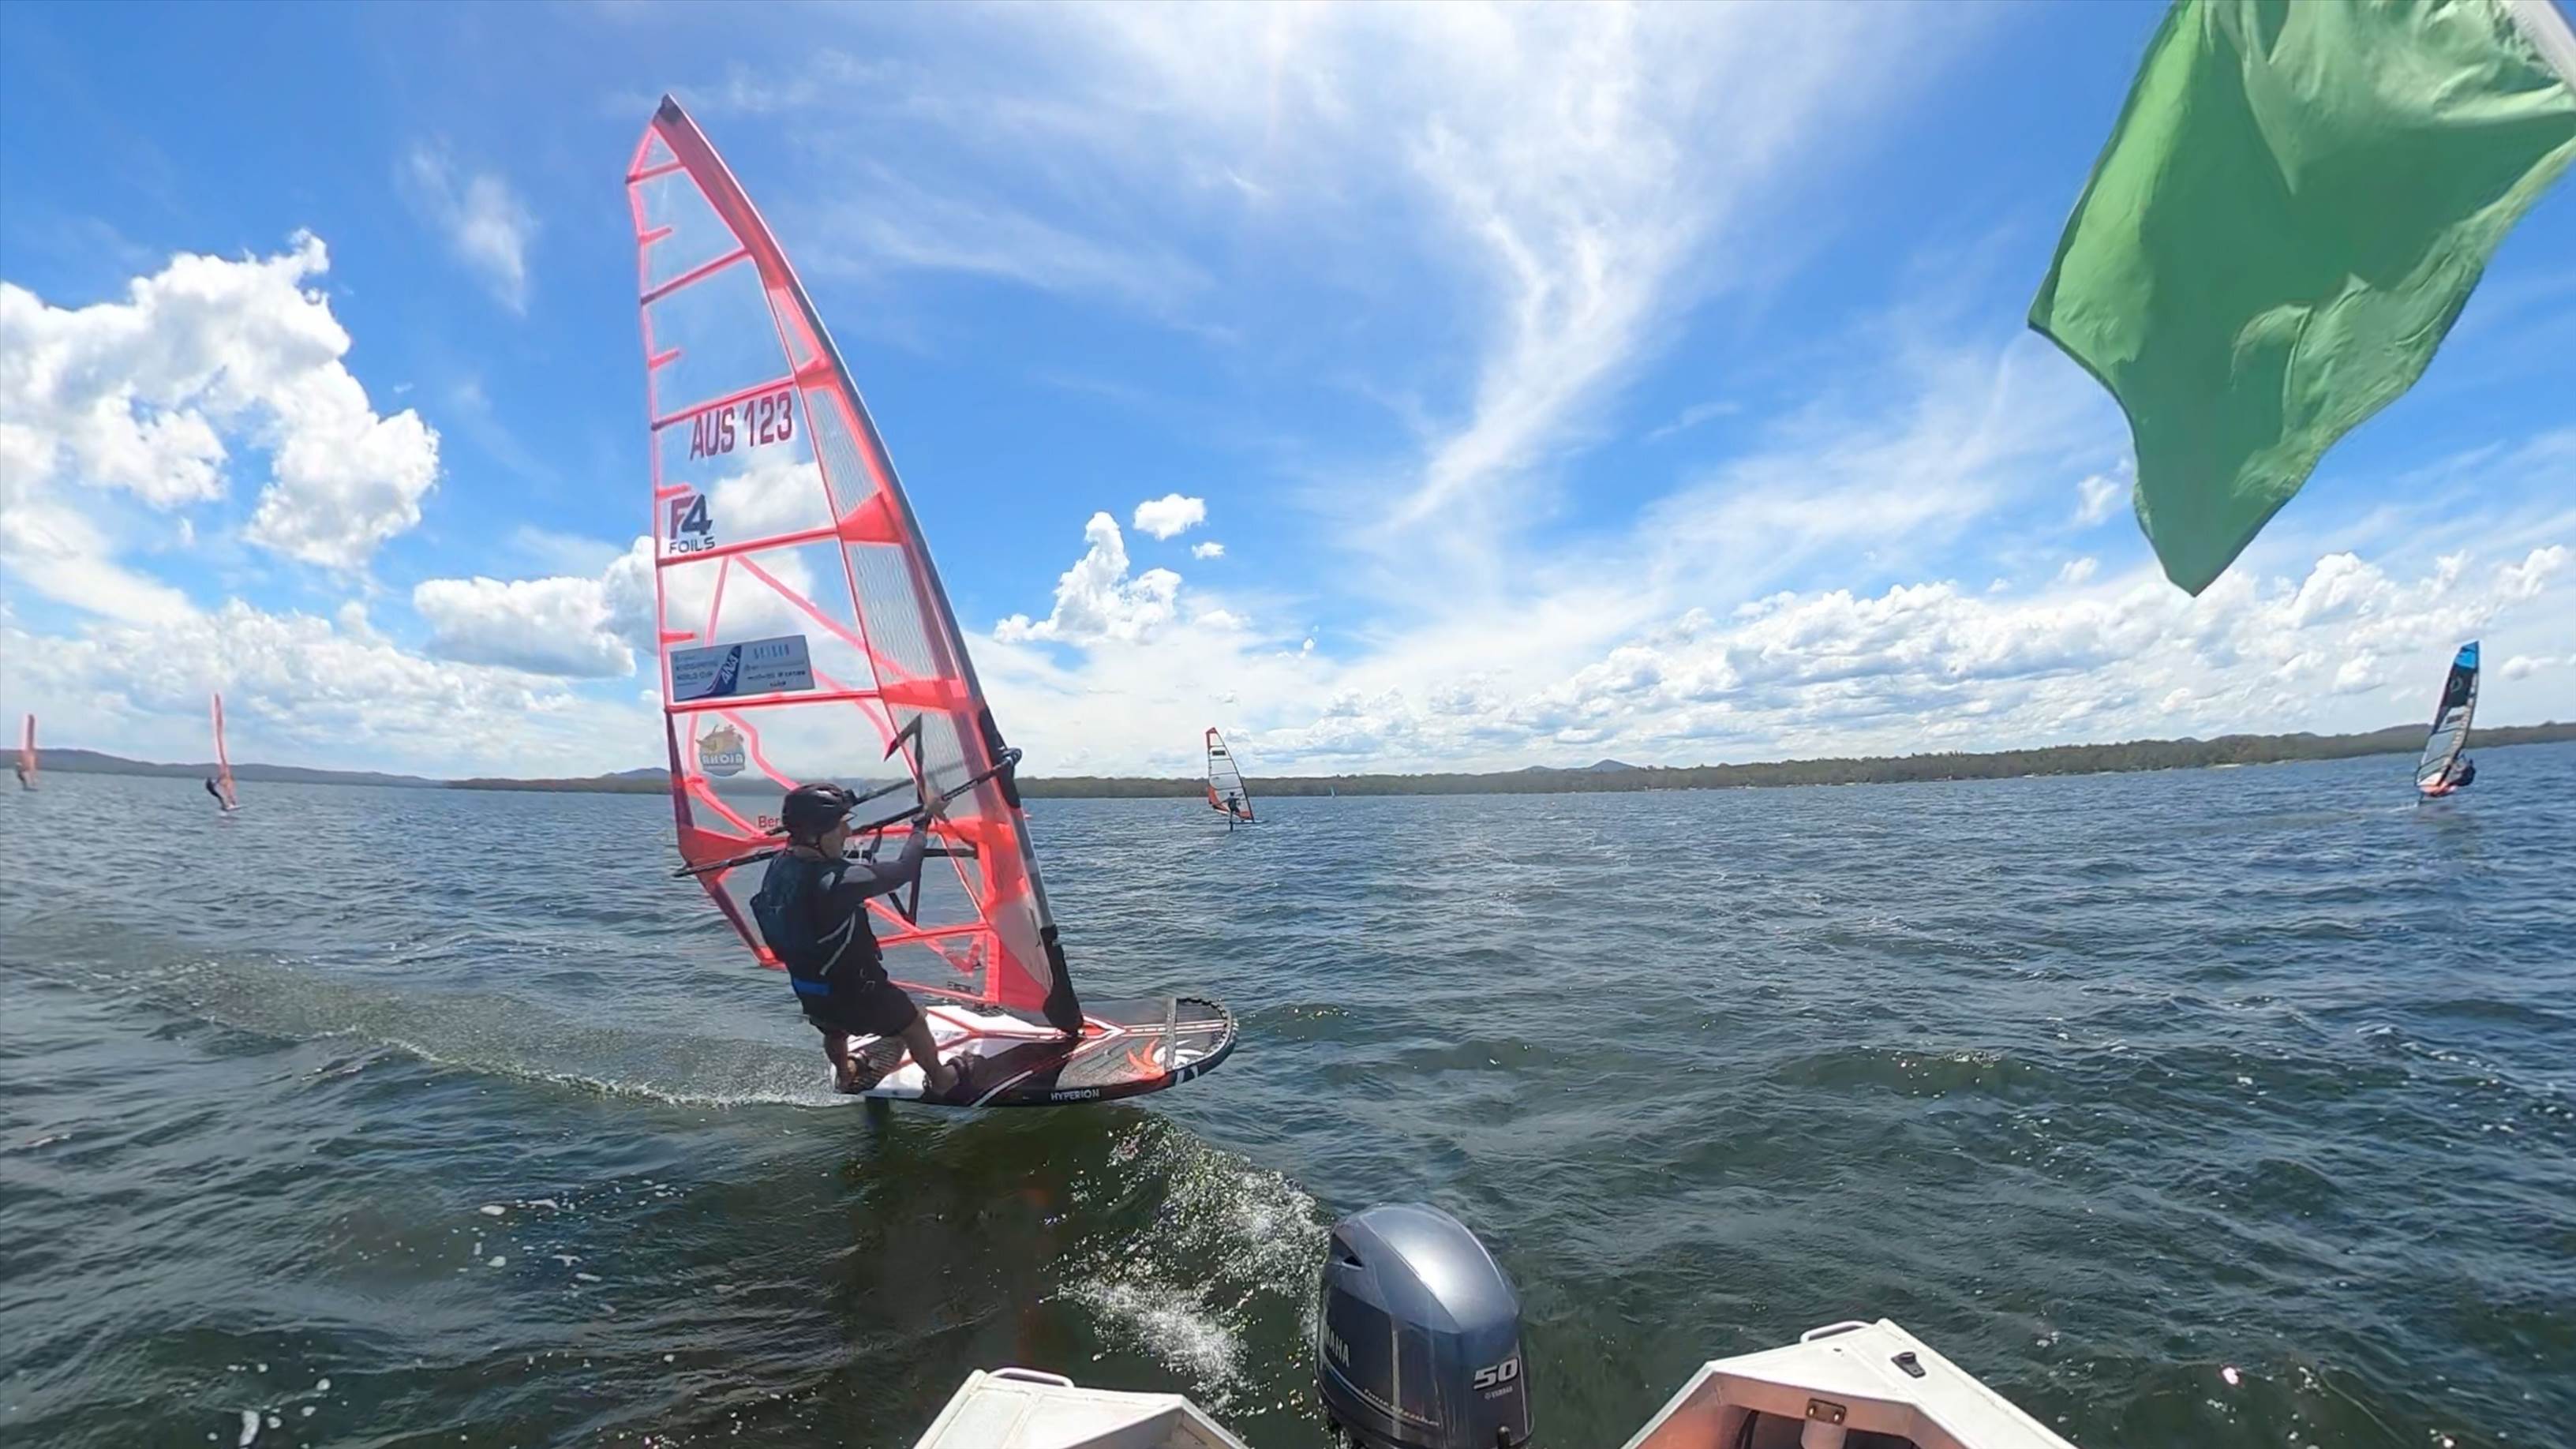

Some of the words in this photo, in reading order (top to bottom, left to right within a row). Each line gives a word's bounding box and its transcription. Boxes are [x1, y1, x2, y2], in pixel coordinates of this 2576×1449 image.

[690, 407, 735, 461] AUS
[744, 391, 792, 447] 123
[671, 494, 713, 540] F4
[669, 537, 715, 553] FOILS
[1050, 1089, 1100, 1101] HYPERION
[1473, 1358, 1518, 1390] 50
